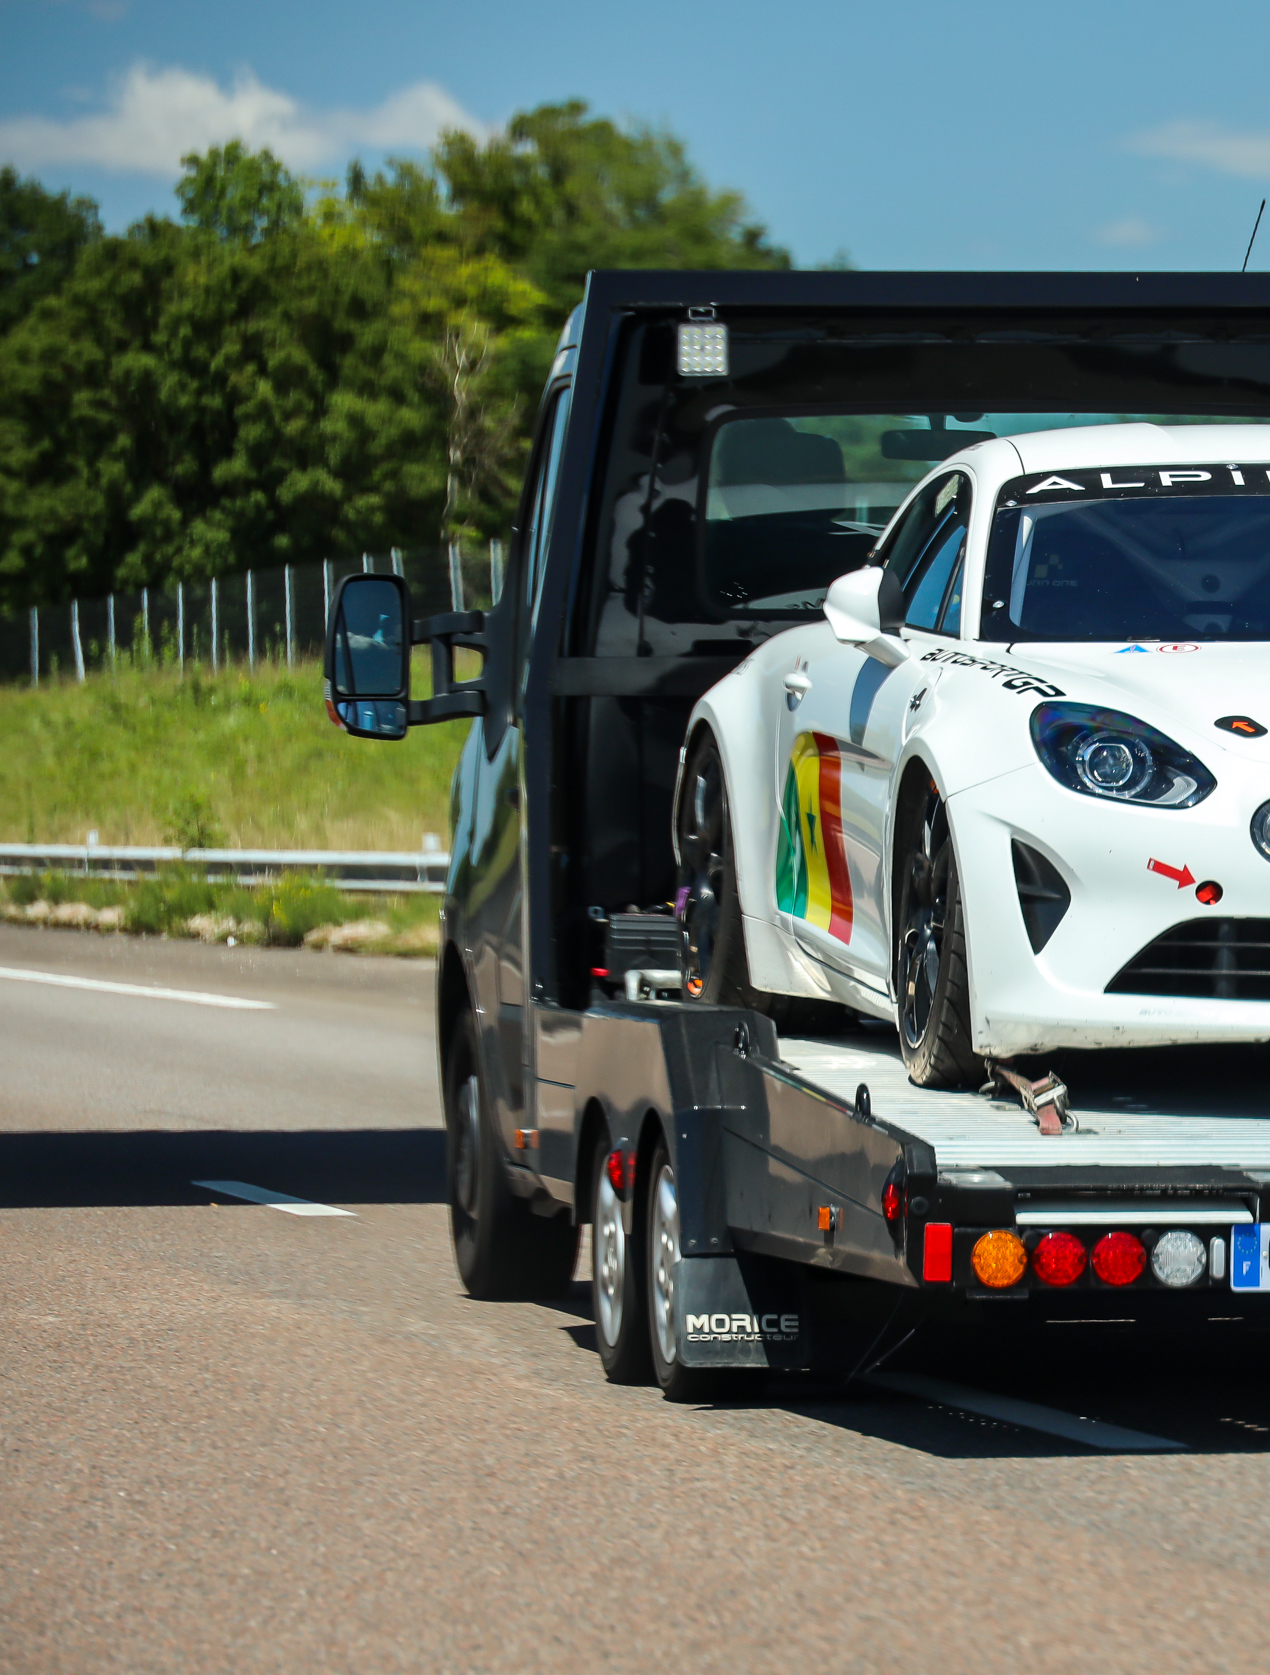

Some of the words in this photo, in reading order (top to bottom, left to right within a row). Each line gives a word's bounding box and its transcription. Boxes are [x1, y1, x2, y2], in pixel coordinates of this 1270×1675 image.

[1242, 1261, 1251, 1276] F
[686, 1314, 799, 1333] MORICE
[687, 1333, 799, 1342] constructeur
